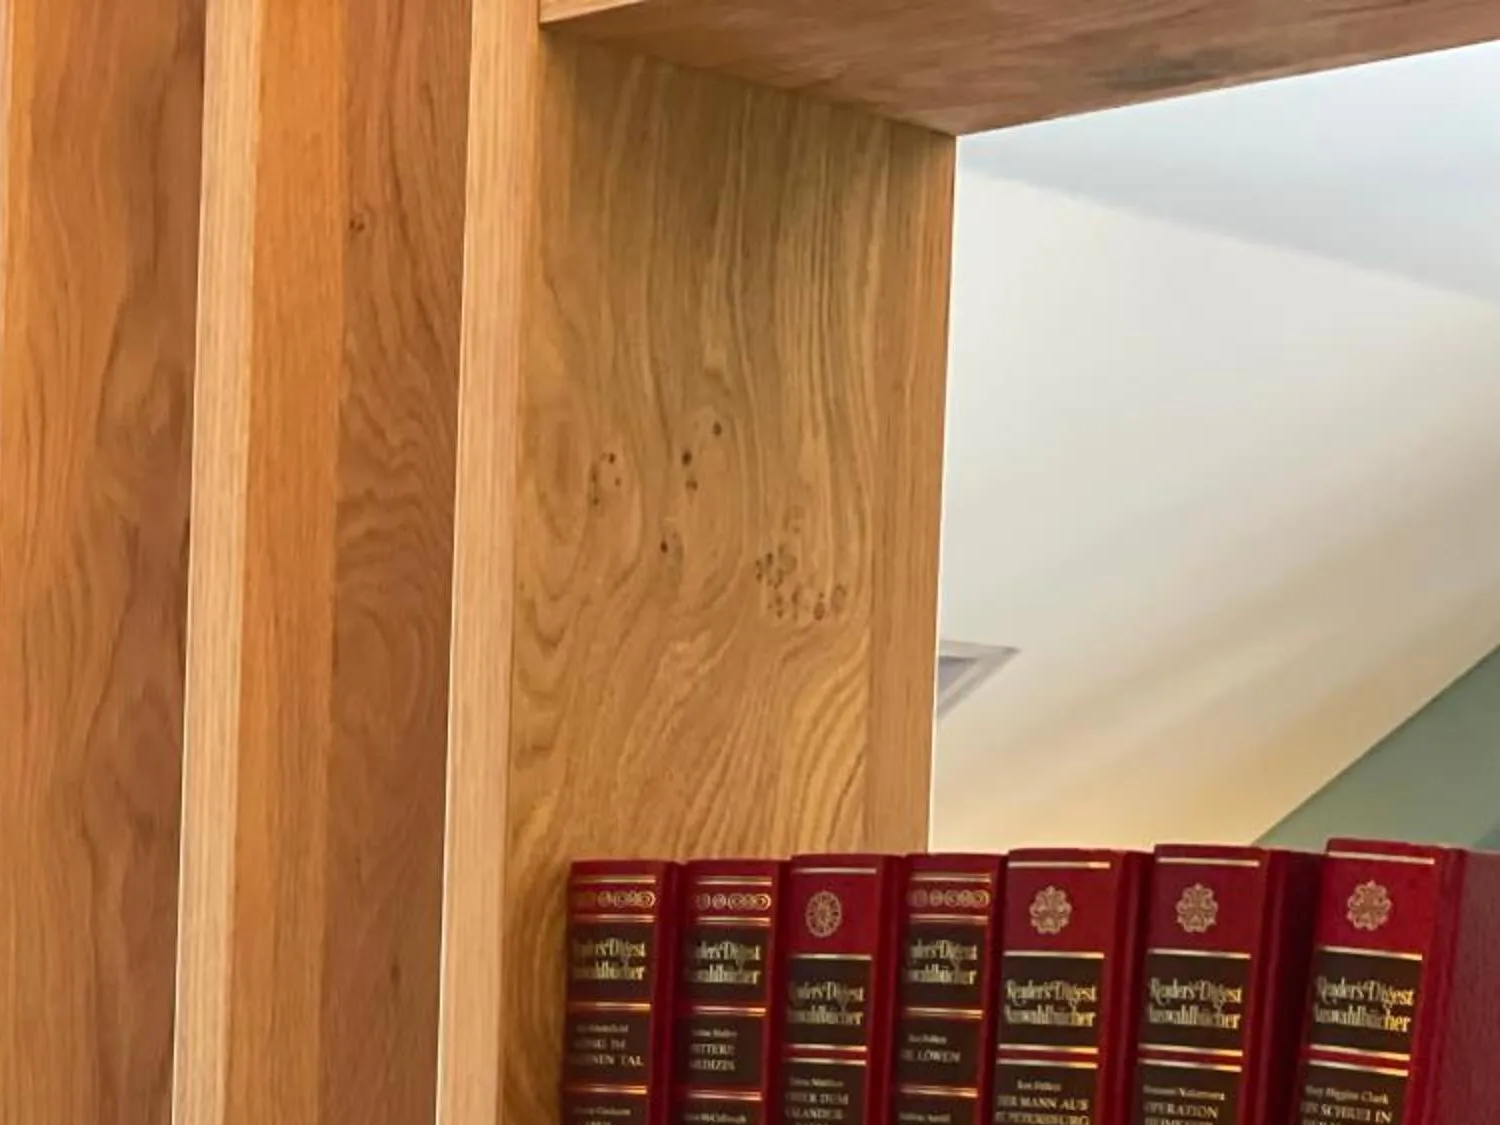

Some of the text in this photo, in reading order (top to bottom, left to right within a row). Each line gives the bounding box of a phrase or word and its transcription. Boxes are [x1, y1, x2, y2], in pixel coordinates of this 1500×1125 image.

[1363, 977, 1414, 1009] Digest
[1143, 1101, 1219, 1119] OPERATION
[1320, 1102, 1372, 1121] SCHREI
